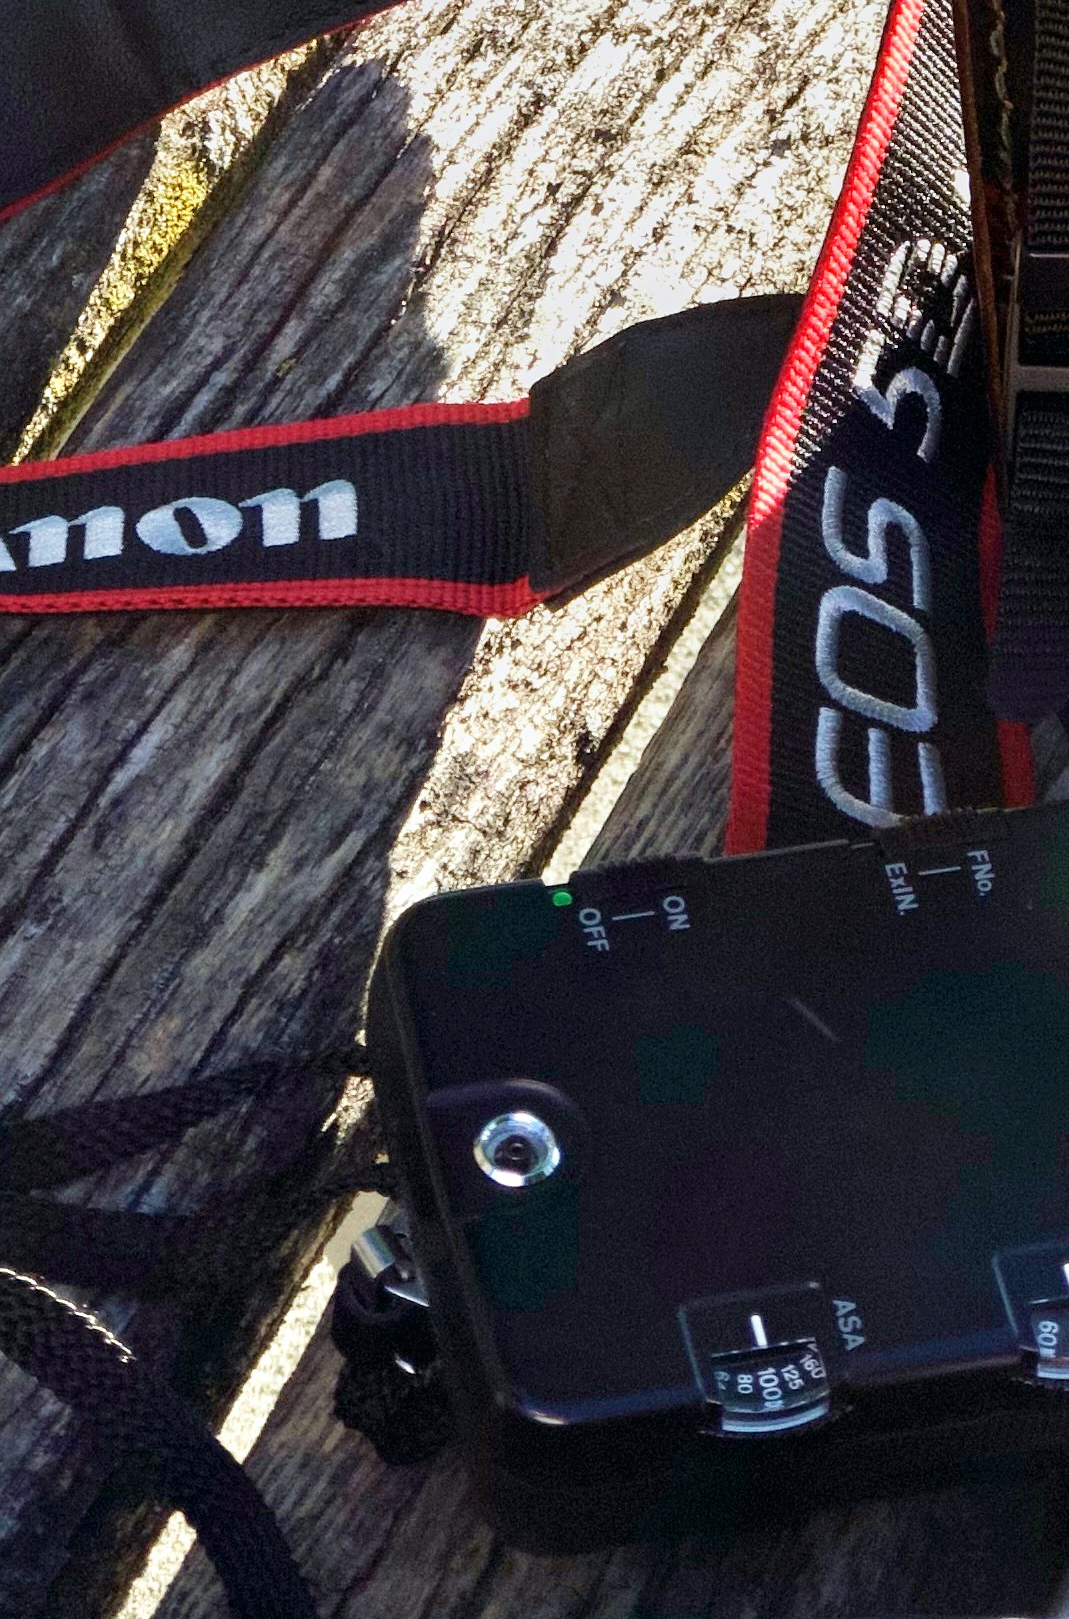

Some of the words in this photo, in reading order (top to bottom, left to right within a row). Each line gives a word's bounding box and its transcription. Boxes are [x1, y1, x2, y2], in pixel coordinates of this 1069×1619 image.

[0, 479, 358, 572] non
[815, 464, 948, 828] EOS
[578, 907, 609, 953] OFF
[662, 895, 690, 932] ON
[832, 1299, 866, 1352] ASA
[737, 1373, 753, 1394] 80
[781, 1363, 804, 1390] 125
